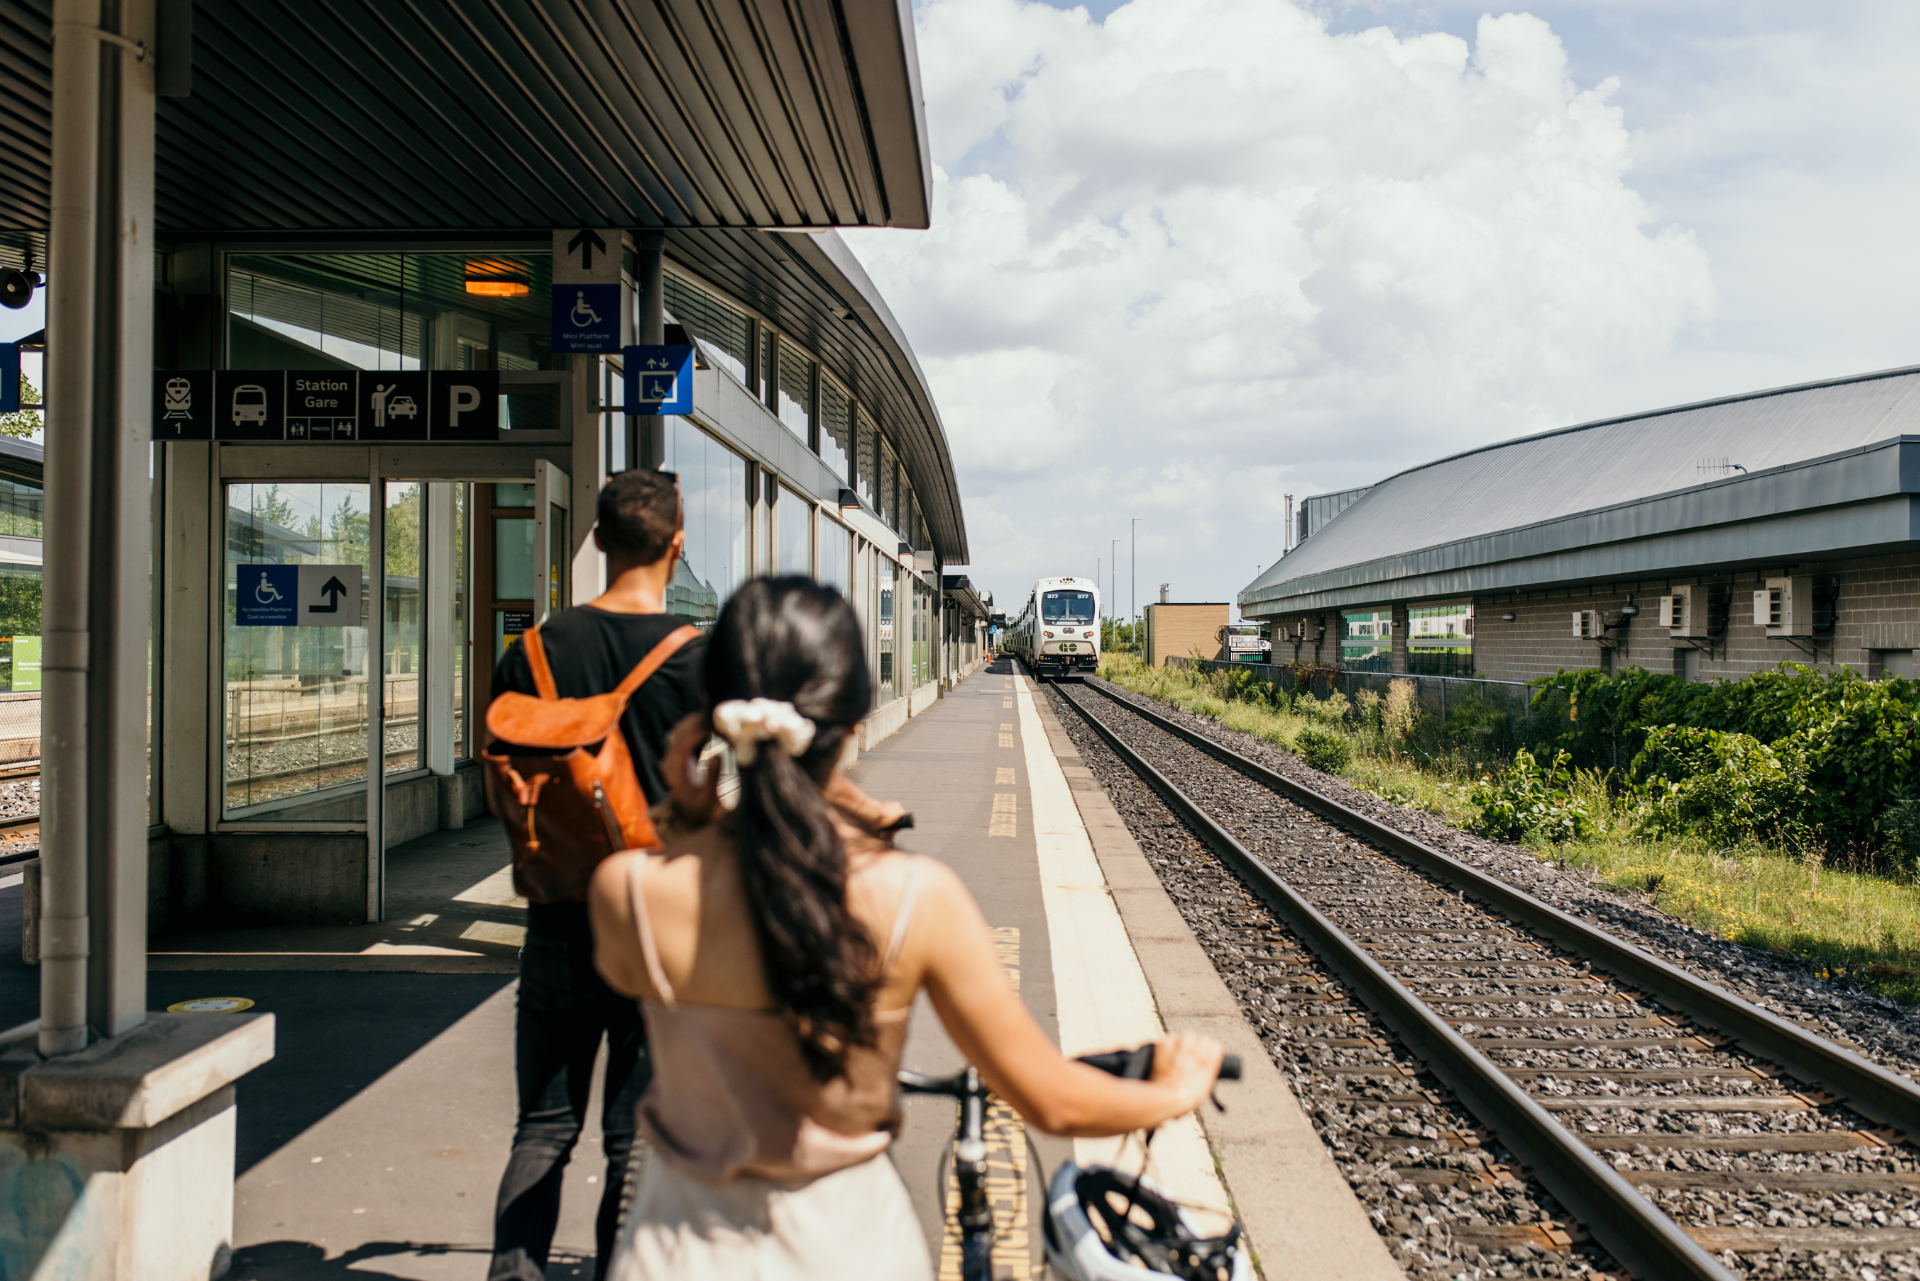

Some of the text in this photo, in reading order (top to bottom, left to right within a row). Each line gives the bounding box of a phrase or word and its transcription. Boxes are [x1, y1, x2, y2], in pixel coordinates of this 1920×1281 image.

[587, 342, 602, 350] quai
[295, 379, 348, 391] Station
[305, 396, 338, 408] Gare
[449, 385, 481, 427] P
[175, 422, 181, 434] 1
[1059, 643, 1077, 652] GO
